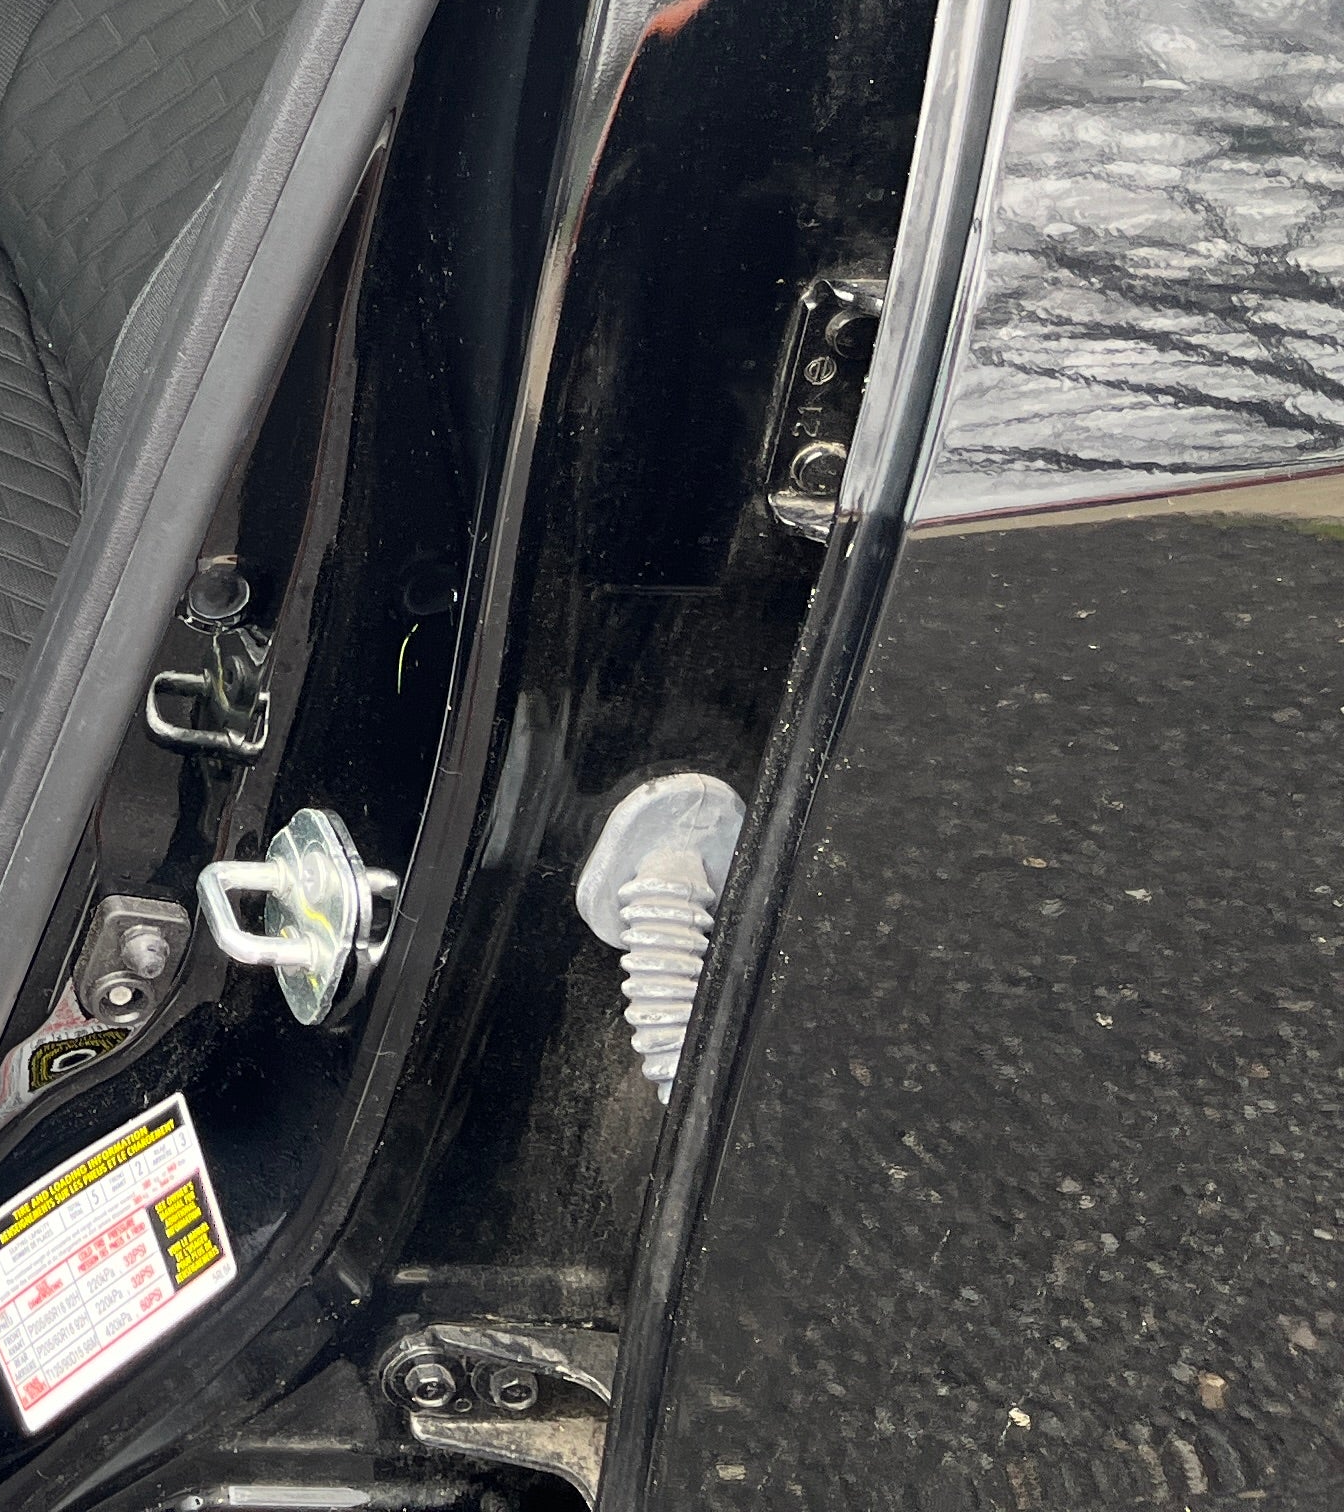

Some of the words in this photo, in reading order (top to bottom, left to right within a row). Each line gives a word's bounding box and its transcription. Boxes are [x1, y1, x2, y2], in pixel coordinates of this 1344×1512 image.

[176, 1131, 188, 1148] 3
[12, 1202, 32, 1221] TIRE
[30, 1191, 50, 1209] AND
[48, 1163, 88, 1196] LOADING
[86, 1125, 149, 1170] INFORMATION
[132, 1160, 145, 1177] 2
[90, 1189, 101, 1204] 5
